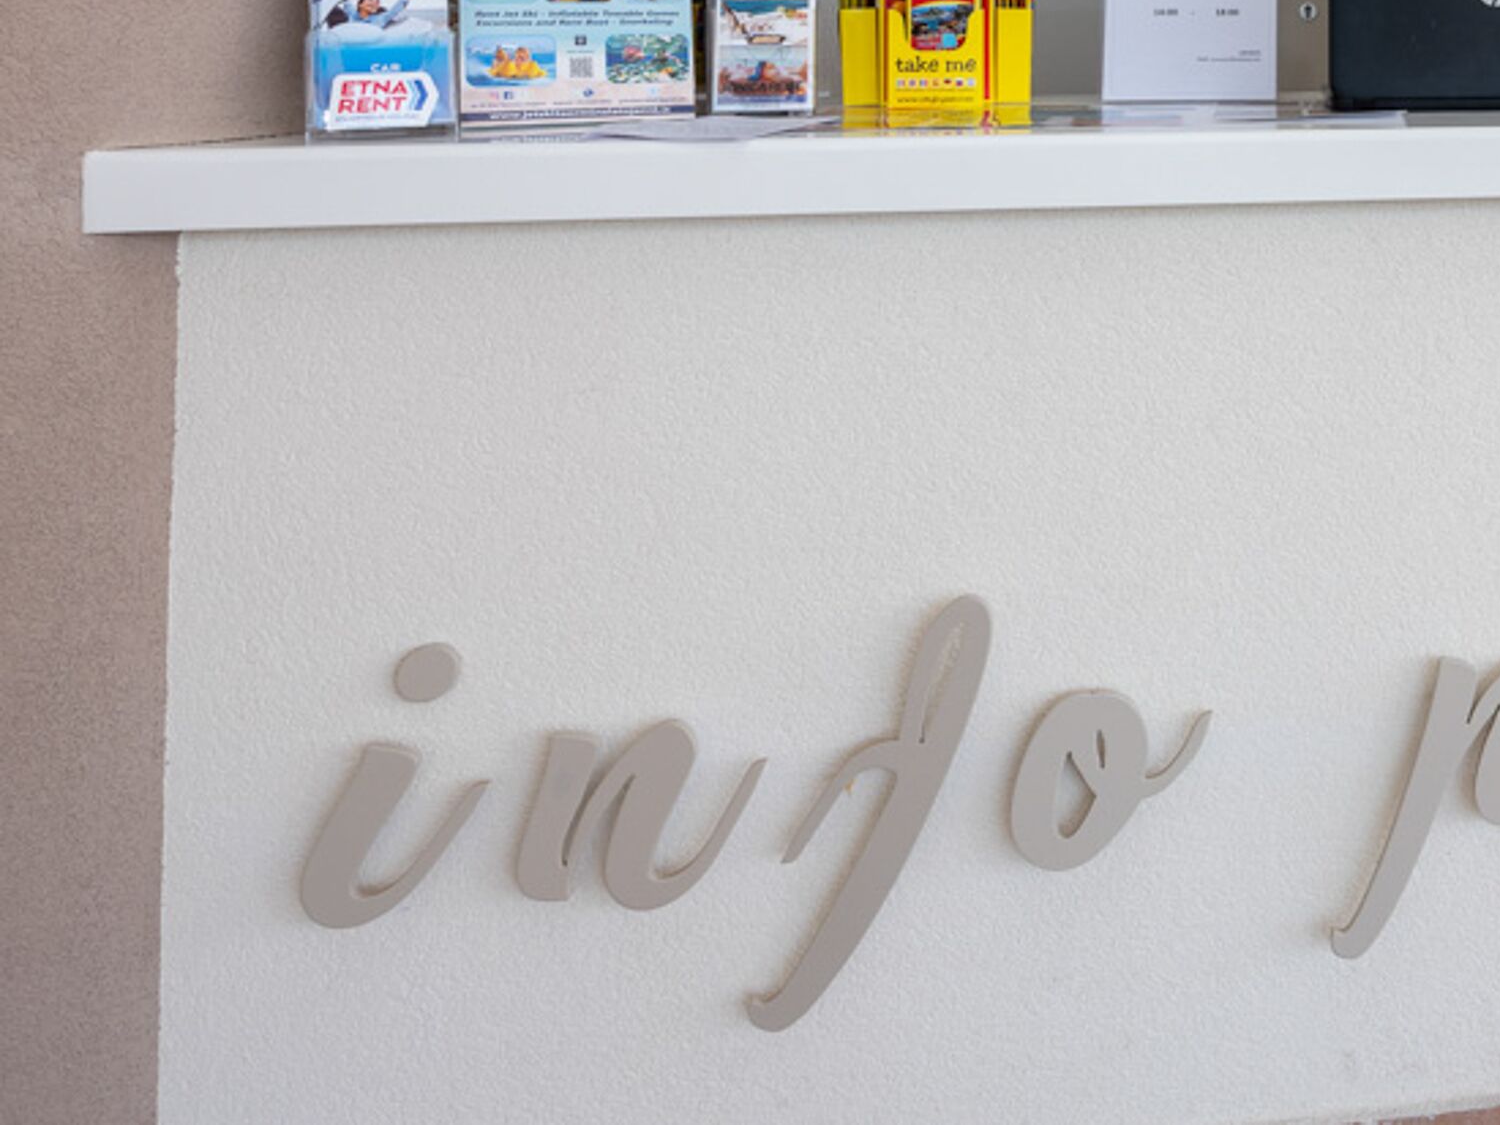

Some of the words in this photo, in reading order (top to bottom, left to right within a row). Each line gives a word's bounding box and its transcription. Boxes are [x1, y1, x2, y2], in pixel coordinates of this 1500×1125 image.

[895, 55, 940, 73] take
[945, 58, 977, 73] me
[341, 79, 408, 96] ETNA
[337, 96, 407, 115] RENT
[300, 593, 1214, 1032] info
